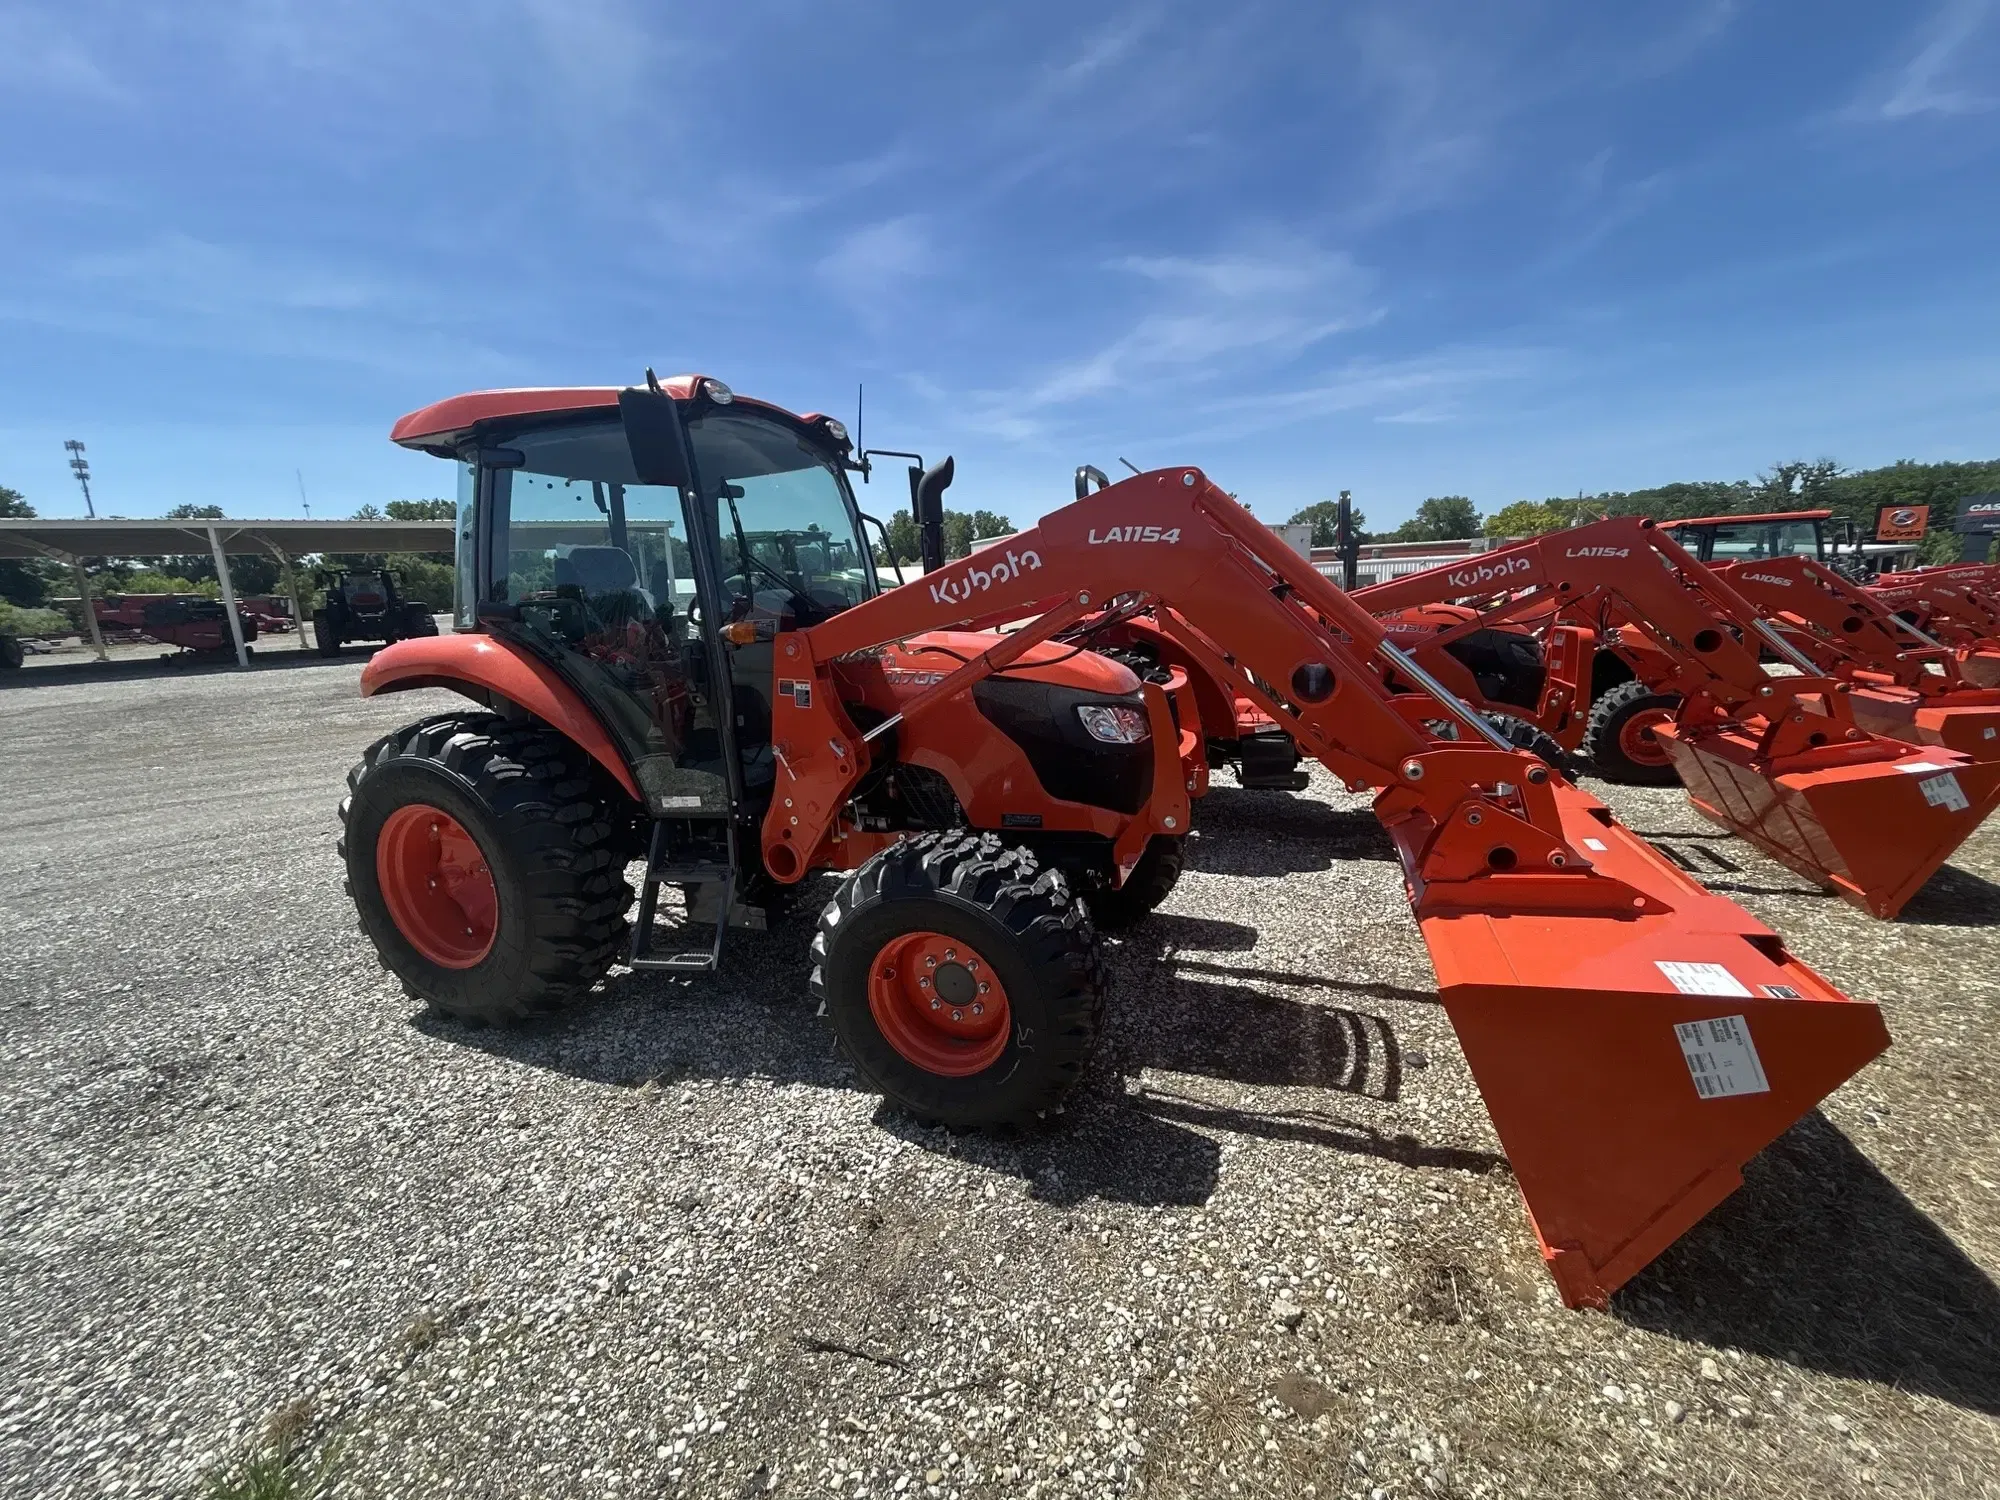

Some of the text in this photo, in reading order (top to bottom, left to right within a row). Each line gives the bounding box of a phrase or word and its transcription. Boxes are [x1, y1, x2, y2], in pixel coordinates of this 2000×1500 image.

[1088, 526, 1181, 544] LA1154
[1881, 529, 1921, 537] Kubota
[1566, 547, 1630, 558] LA1154
[929, 549, 1043, 605] Kubota
[1448, 557, 1530, 587] Kubota
[1741, 572, 1794, 587] LA1065
